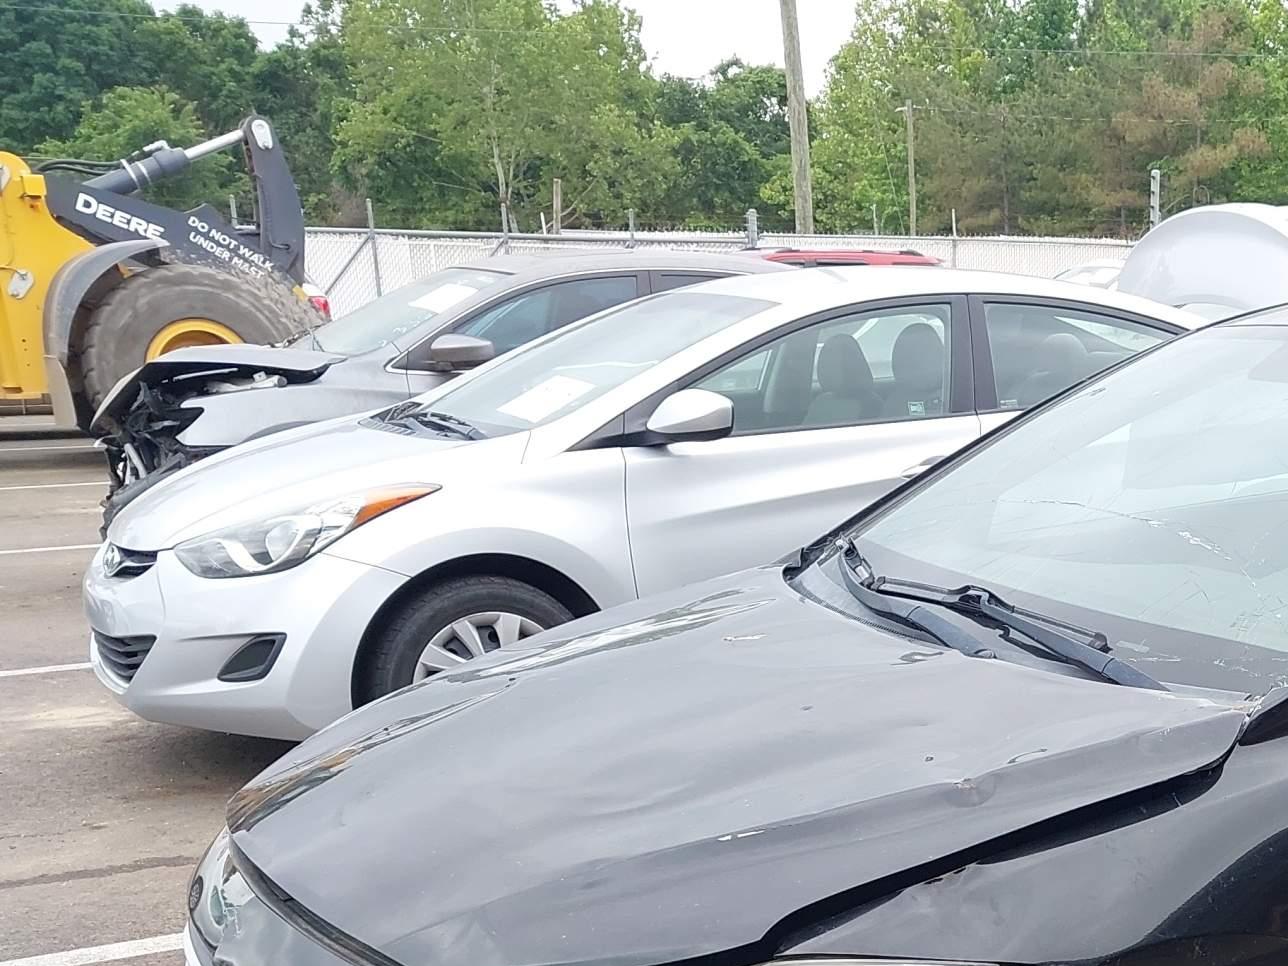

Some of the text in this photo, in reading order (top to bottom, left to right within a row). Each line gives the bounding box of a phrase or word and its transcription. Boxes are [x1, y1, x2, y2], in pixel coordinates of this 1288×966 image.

[75, 192, 164, 240] DEERE
[187, 216, 274, 272] DO NOT WALK
[189, 232, 264, 279] UNDER MAST
